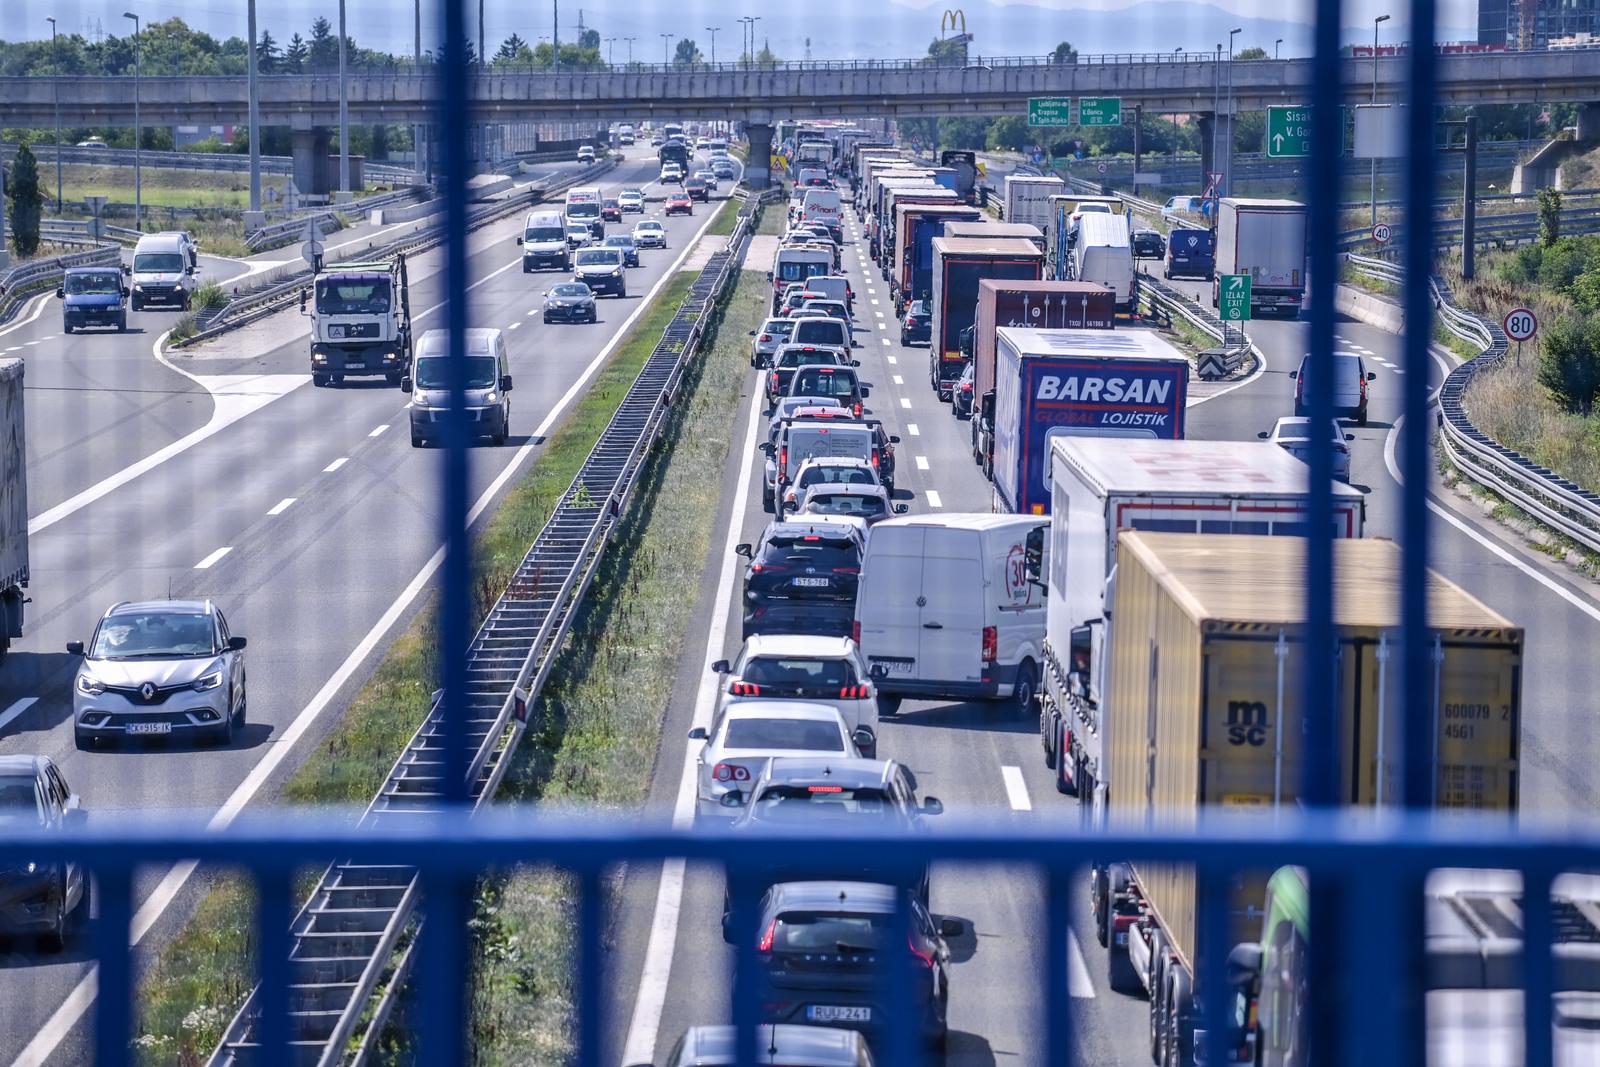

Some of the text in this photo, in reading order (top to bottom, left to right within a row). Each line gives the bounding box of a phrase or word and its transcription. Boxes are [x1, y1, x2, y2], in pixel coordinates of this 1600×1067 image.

[1375, 228, 1388, 239] 40
[1225, 291, 1246, 299] IZLAZ
[1227, 299, 1243, 307] EXIT
[1510, 316, 1531, 334] 80
[1036, 375, 1172, 404] BARSAN
[1035, 411, 1096, 425] GLOBAL
